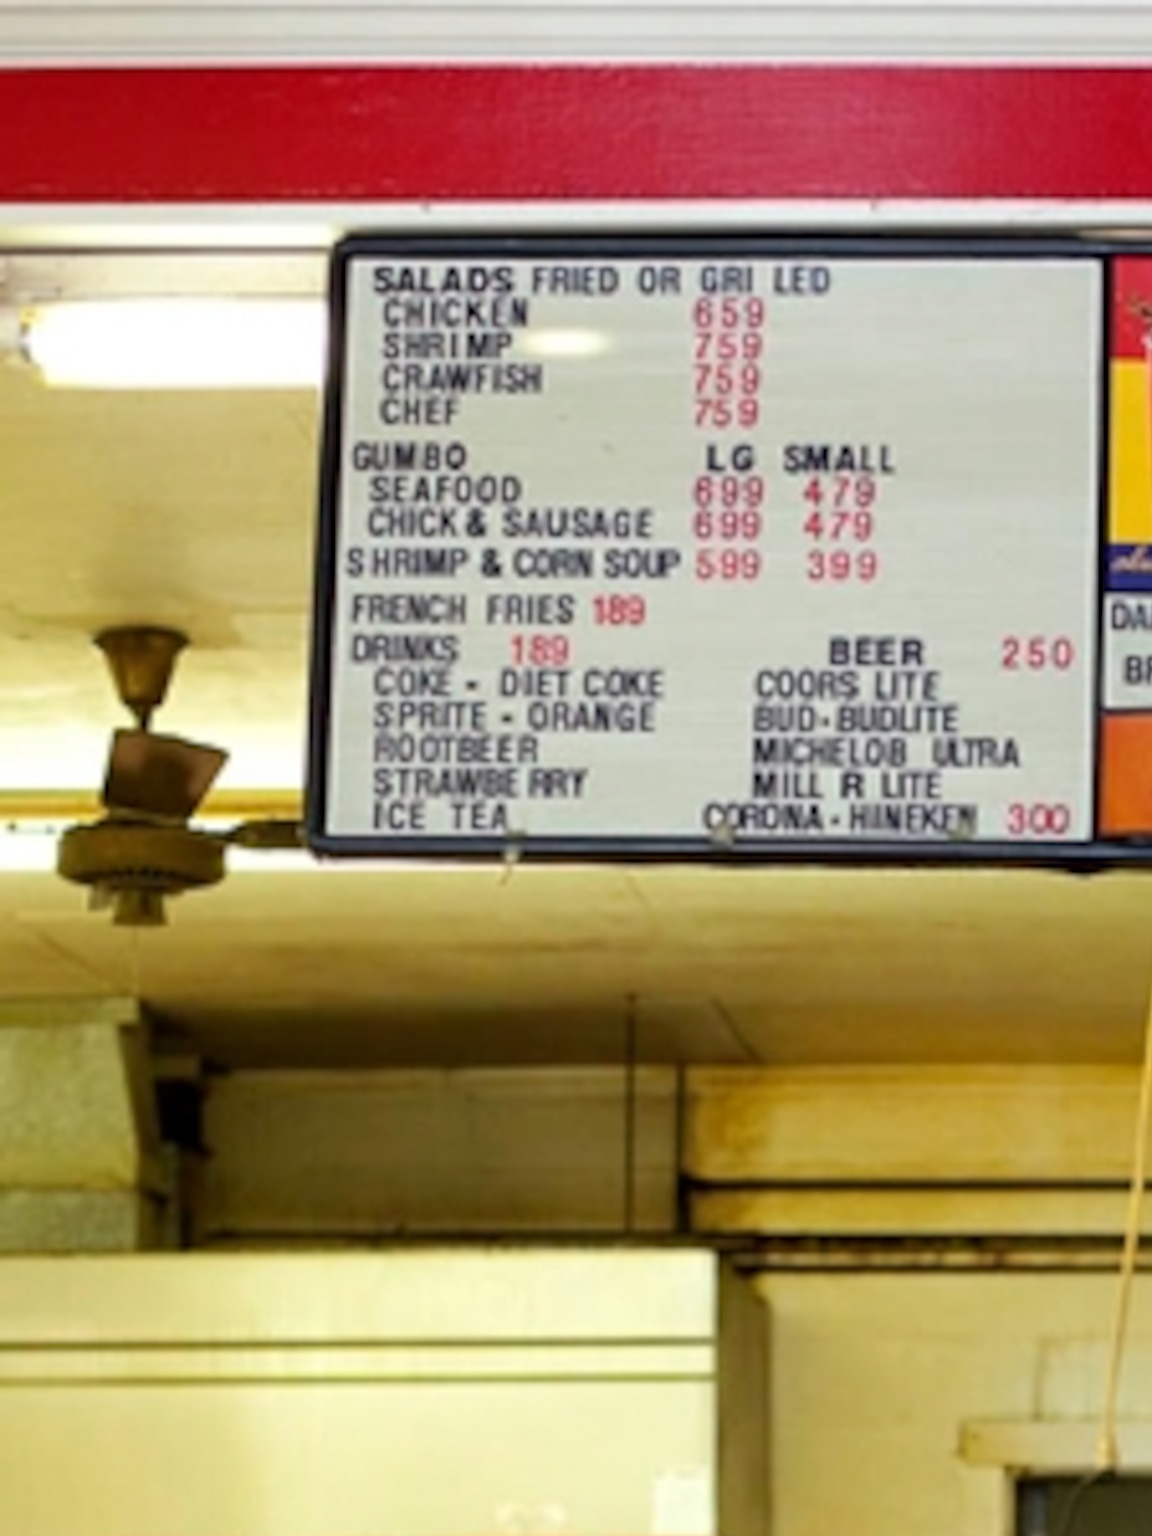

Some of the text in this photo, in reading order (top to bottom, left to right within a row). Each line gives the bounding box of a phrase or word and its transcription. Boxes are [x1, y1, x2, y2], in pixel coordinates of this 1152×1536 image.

[374, 266, 514, 294] SALADS
[532, 266, 620, 294] FRIED
[638, 267, 682, 294] OR
[383, 297, 765, 329] CHICKEN 659
[383, 332, 764, 361] SHRIMP 759
[382, 362, 763, 395] CRAWFISH 759
[379, 397, 760, 429] CHEF 759
[352, 442, 896, 474] GUMBO LG SMALL
[369, 475, 876, 508] SEAFOOD 699 479
[367, 507, 872, 541] CHICK & SAUSAGE 699 479
[347, 548, 879, 582] SHRIMP & CORN SOUP 599 399
[350, 594, 647, 626] FRENCH FRIES 189
[351, 634, 570, 666] DRINKS 189
[829, 637, 1075, 671] BEER 250
[373, 668, 452, 697] COKE
[500, 669, 571, 698] DIET
[583, 669, 665, 698] COKE
[755, 671, 941, 700] COORS LITE
[373, 701, 487, 730] SPRITE
[527, 702, 655, 732] ORANGE
[373, 734, 538, 763] ROOTBEER
[752, 738, 1021, 768] MICHELOB ULTRA
[882, 772, 943, 800] LITE
[373, 802, 508, 830] ICE TEA
[1007, 803, 1072, 835] 300
